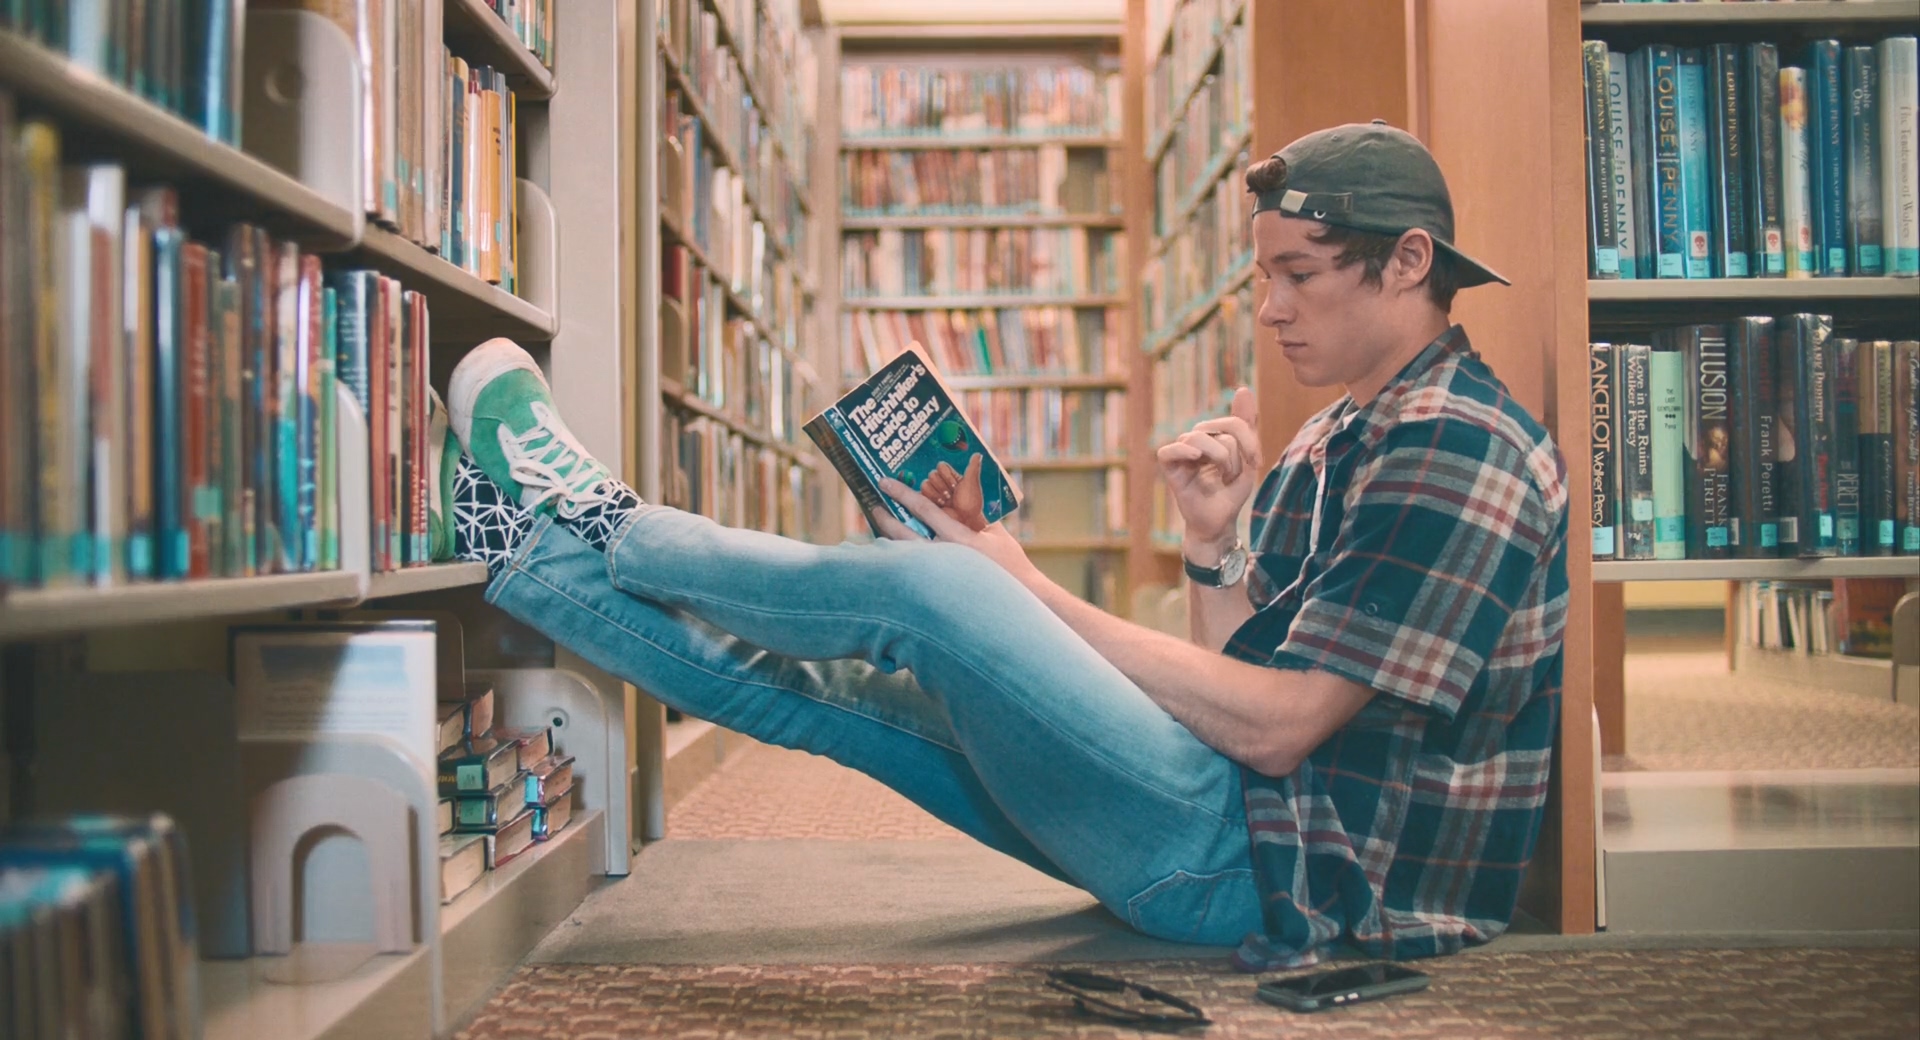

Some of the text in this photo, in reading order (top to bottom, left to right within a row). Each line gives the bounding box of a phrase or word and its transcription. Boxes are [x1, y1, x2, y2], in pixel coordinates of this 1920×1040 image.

[1595, 60, 1606, 131] LOUISE PENNY
[1657, 65, 1675, 148] LOUISE
[1726, 71, 1738, 158] LOUISE PENNY
[1852, 88, 1862, 116] Ones
[1862, 65, 1872, 109] Invisible
[1830, 110, 1840, 146] PENNY
[1600, 156, 1609, 199] BEAUTIFUL
[1661, 167, 1680, 244] PENNY
[1602, 202, 1611, 239] MYSTERY
[1903, 201, 1913, 240] Wolves
[859, 363, 926, 438] Hitchhiker's
[1592, 347, 1610, 452] LANCELOT
[1626, 356, 1639, 447] Walker Percy
[1699, 337, 1728, 419] ILLUSION
[1813, 330, 1826, 423] FRANK PERETTI
[848, 397, 877, 426] The
[869, 410, 908, 450] Guide
[903, 396, 919, 417] to
[878, 437, 902, 463] the
[898, 395, 940, 442] Galaxy
[1636, 355, 1650, 475] Love in the Ruins
[887, 423, 931, 470] DOUGLAS ADAMS
[1593, 451, 1605, 492] Walker
[1761, 415, 1773, 512] Frank Peretti
[1591, 494, 1606, 528] Percy
[1703, 467, 1715, 532] PERETT
[1716, 474, 1729, 527] FRANK
